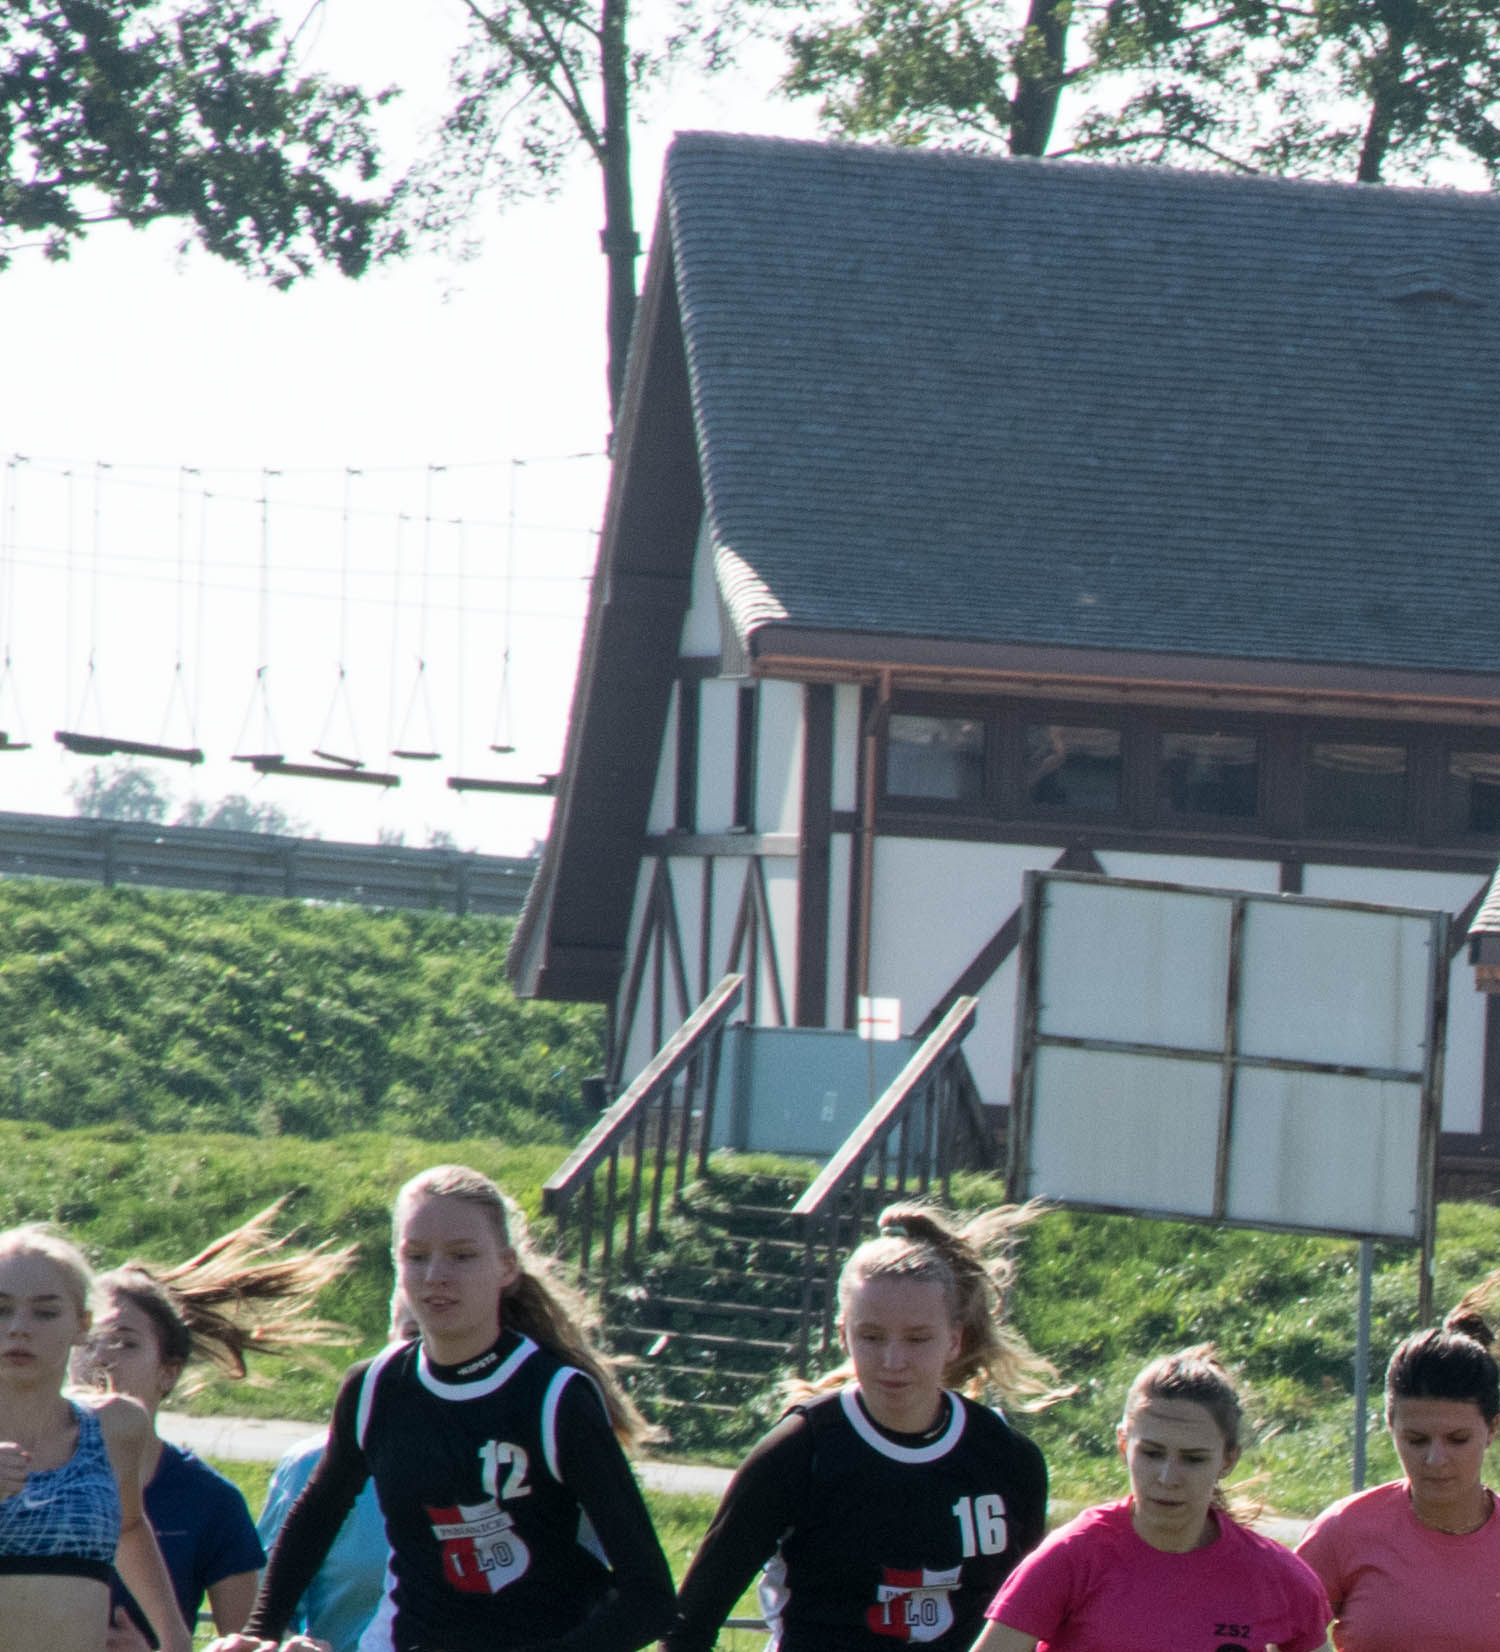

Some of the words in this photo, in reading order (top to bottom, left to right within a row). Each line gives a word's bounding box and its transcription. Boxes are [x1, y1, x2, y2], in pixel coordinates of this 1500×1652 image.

[477, 1439, 532, 1500] 12
[952, 1494, 1008, 1557] 16
[904, 1598, 938, 1626] LO
